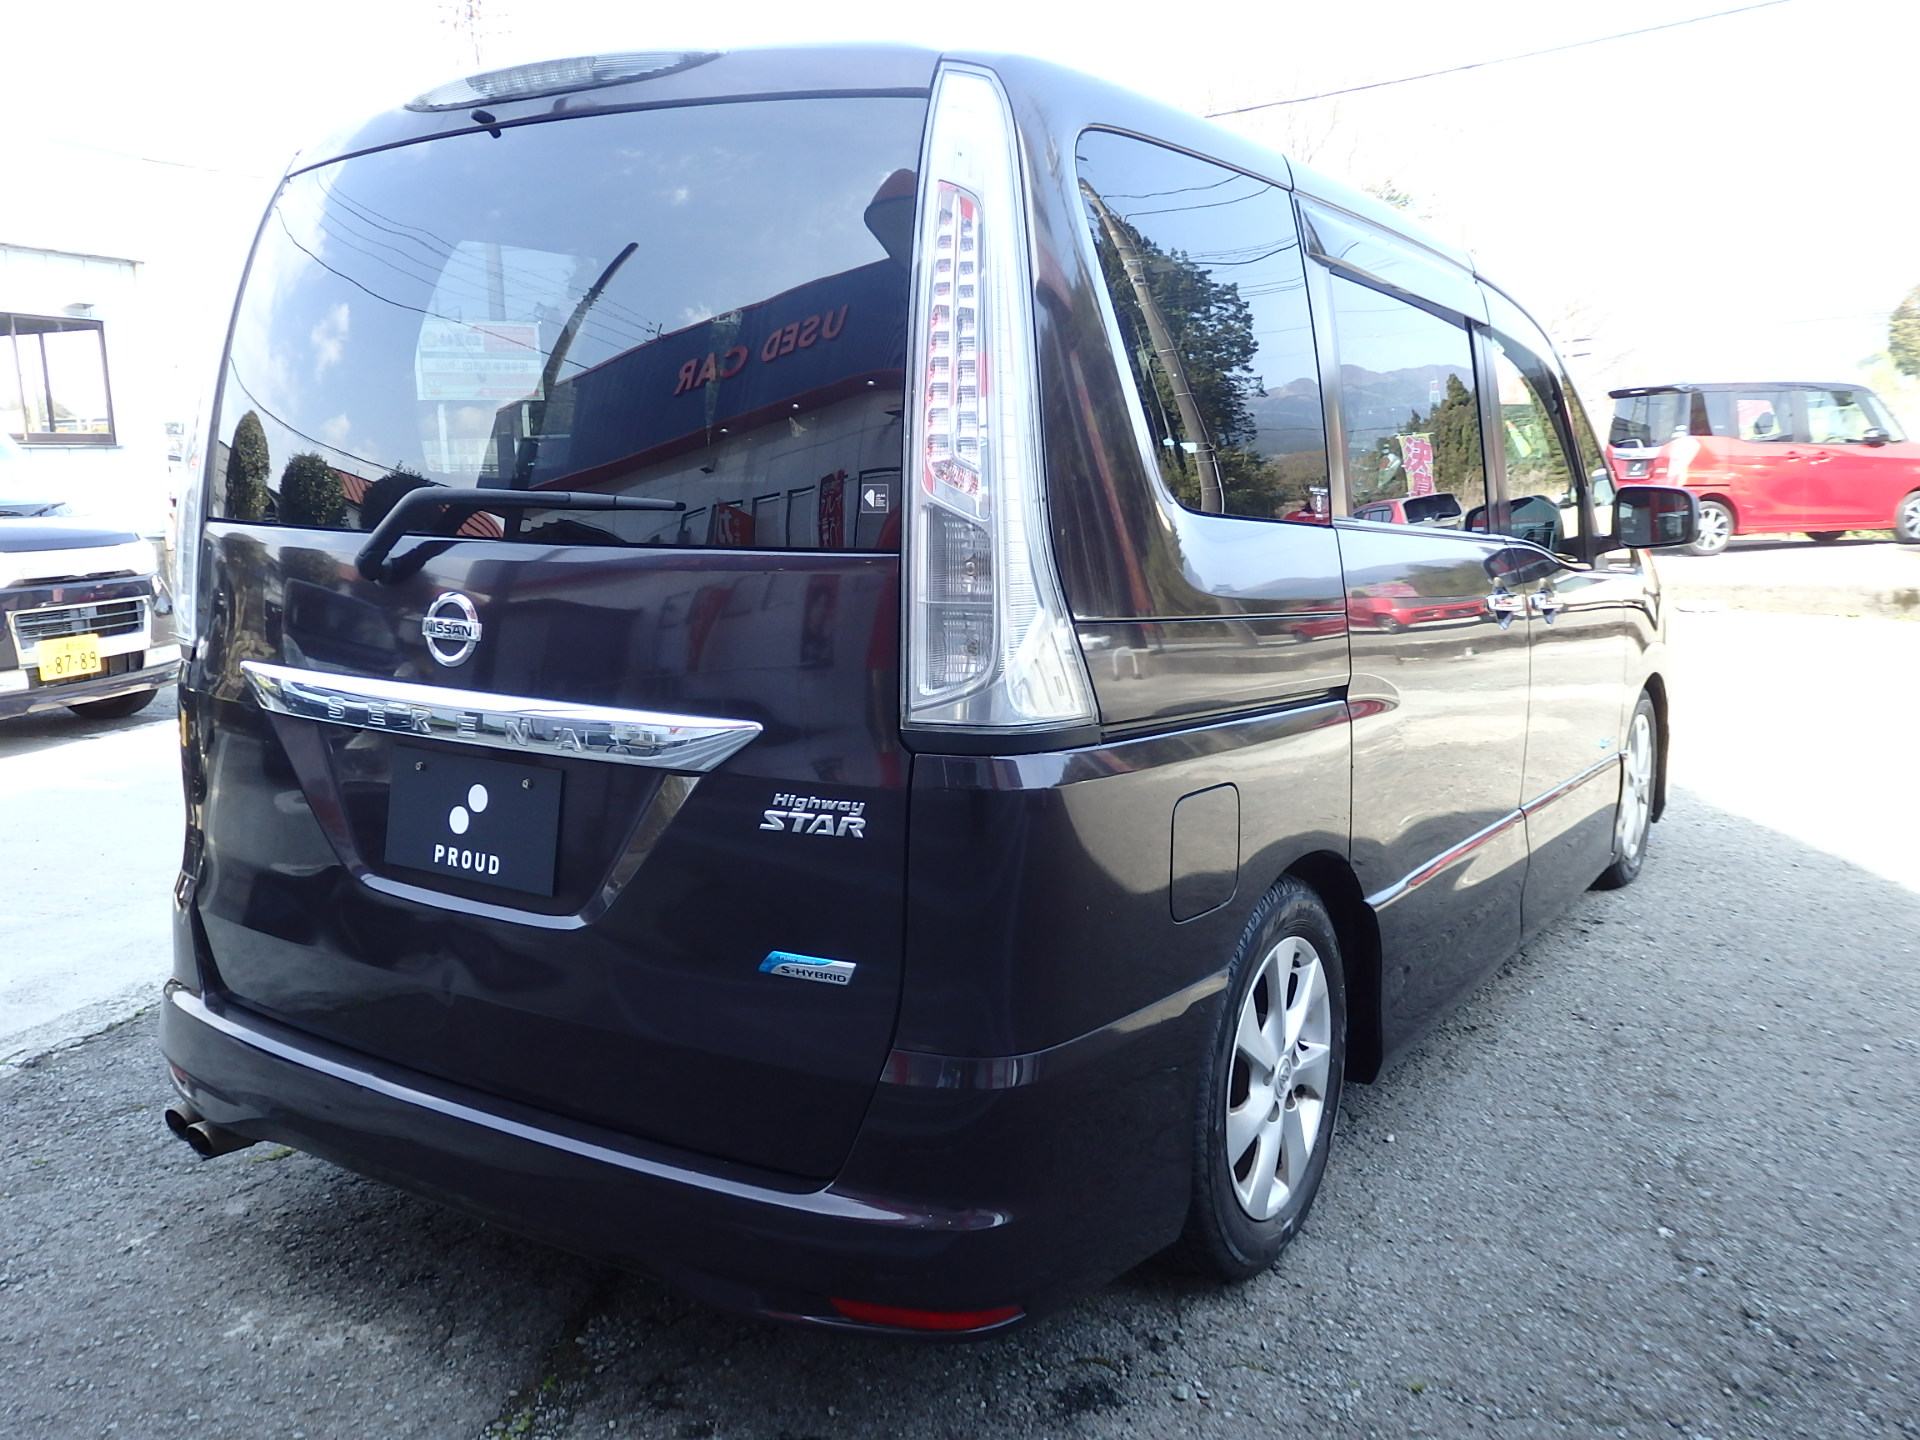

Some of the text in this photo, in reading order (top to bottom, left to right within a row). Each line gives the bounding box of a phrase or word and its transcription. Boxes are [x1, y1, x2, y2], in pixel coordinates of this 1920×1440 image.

[425, 619, 473, 637] NISSAN
[55, 651, 97, 674] 87-89
[327, 696, 583, 752] SERENA
[772, 793, 866, 816] Highway
[759, 809, 866, 838] STAR
[434, 844, 500, 875] PROUD
[781, 965, 847, 982] S-HYBRID
